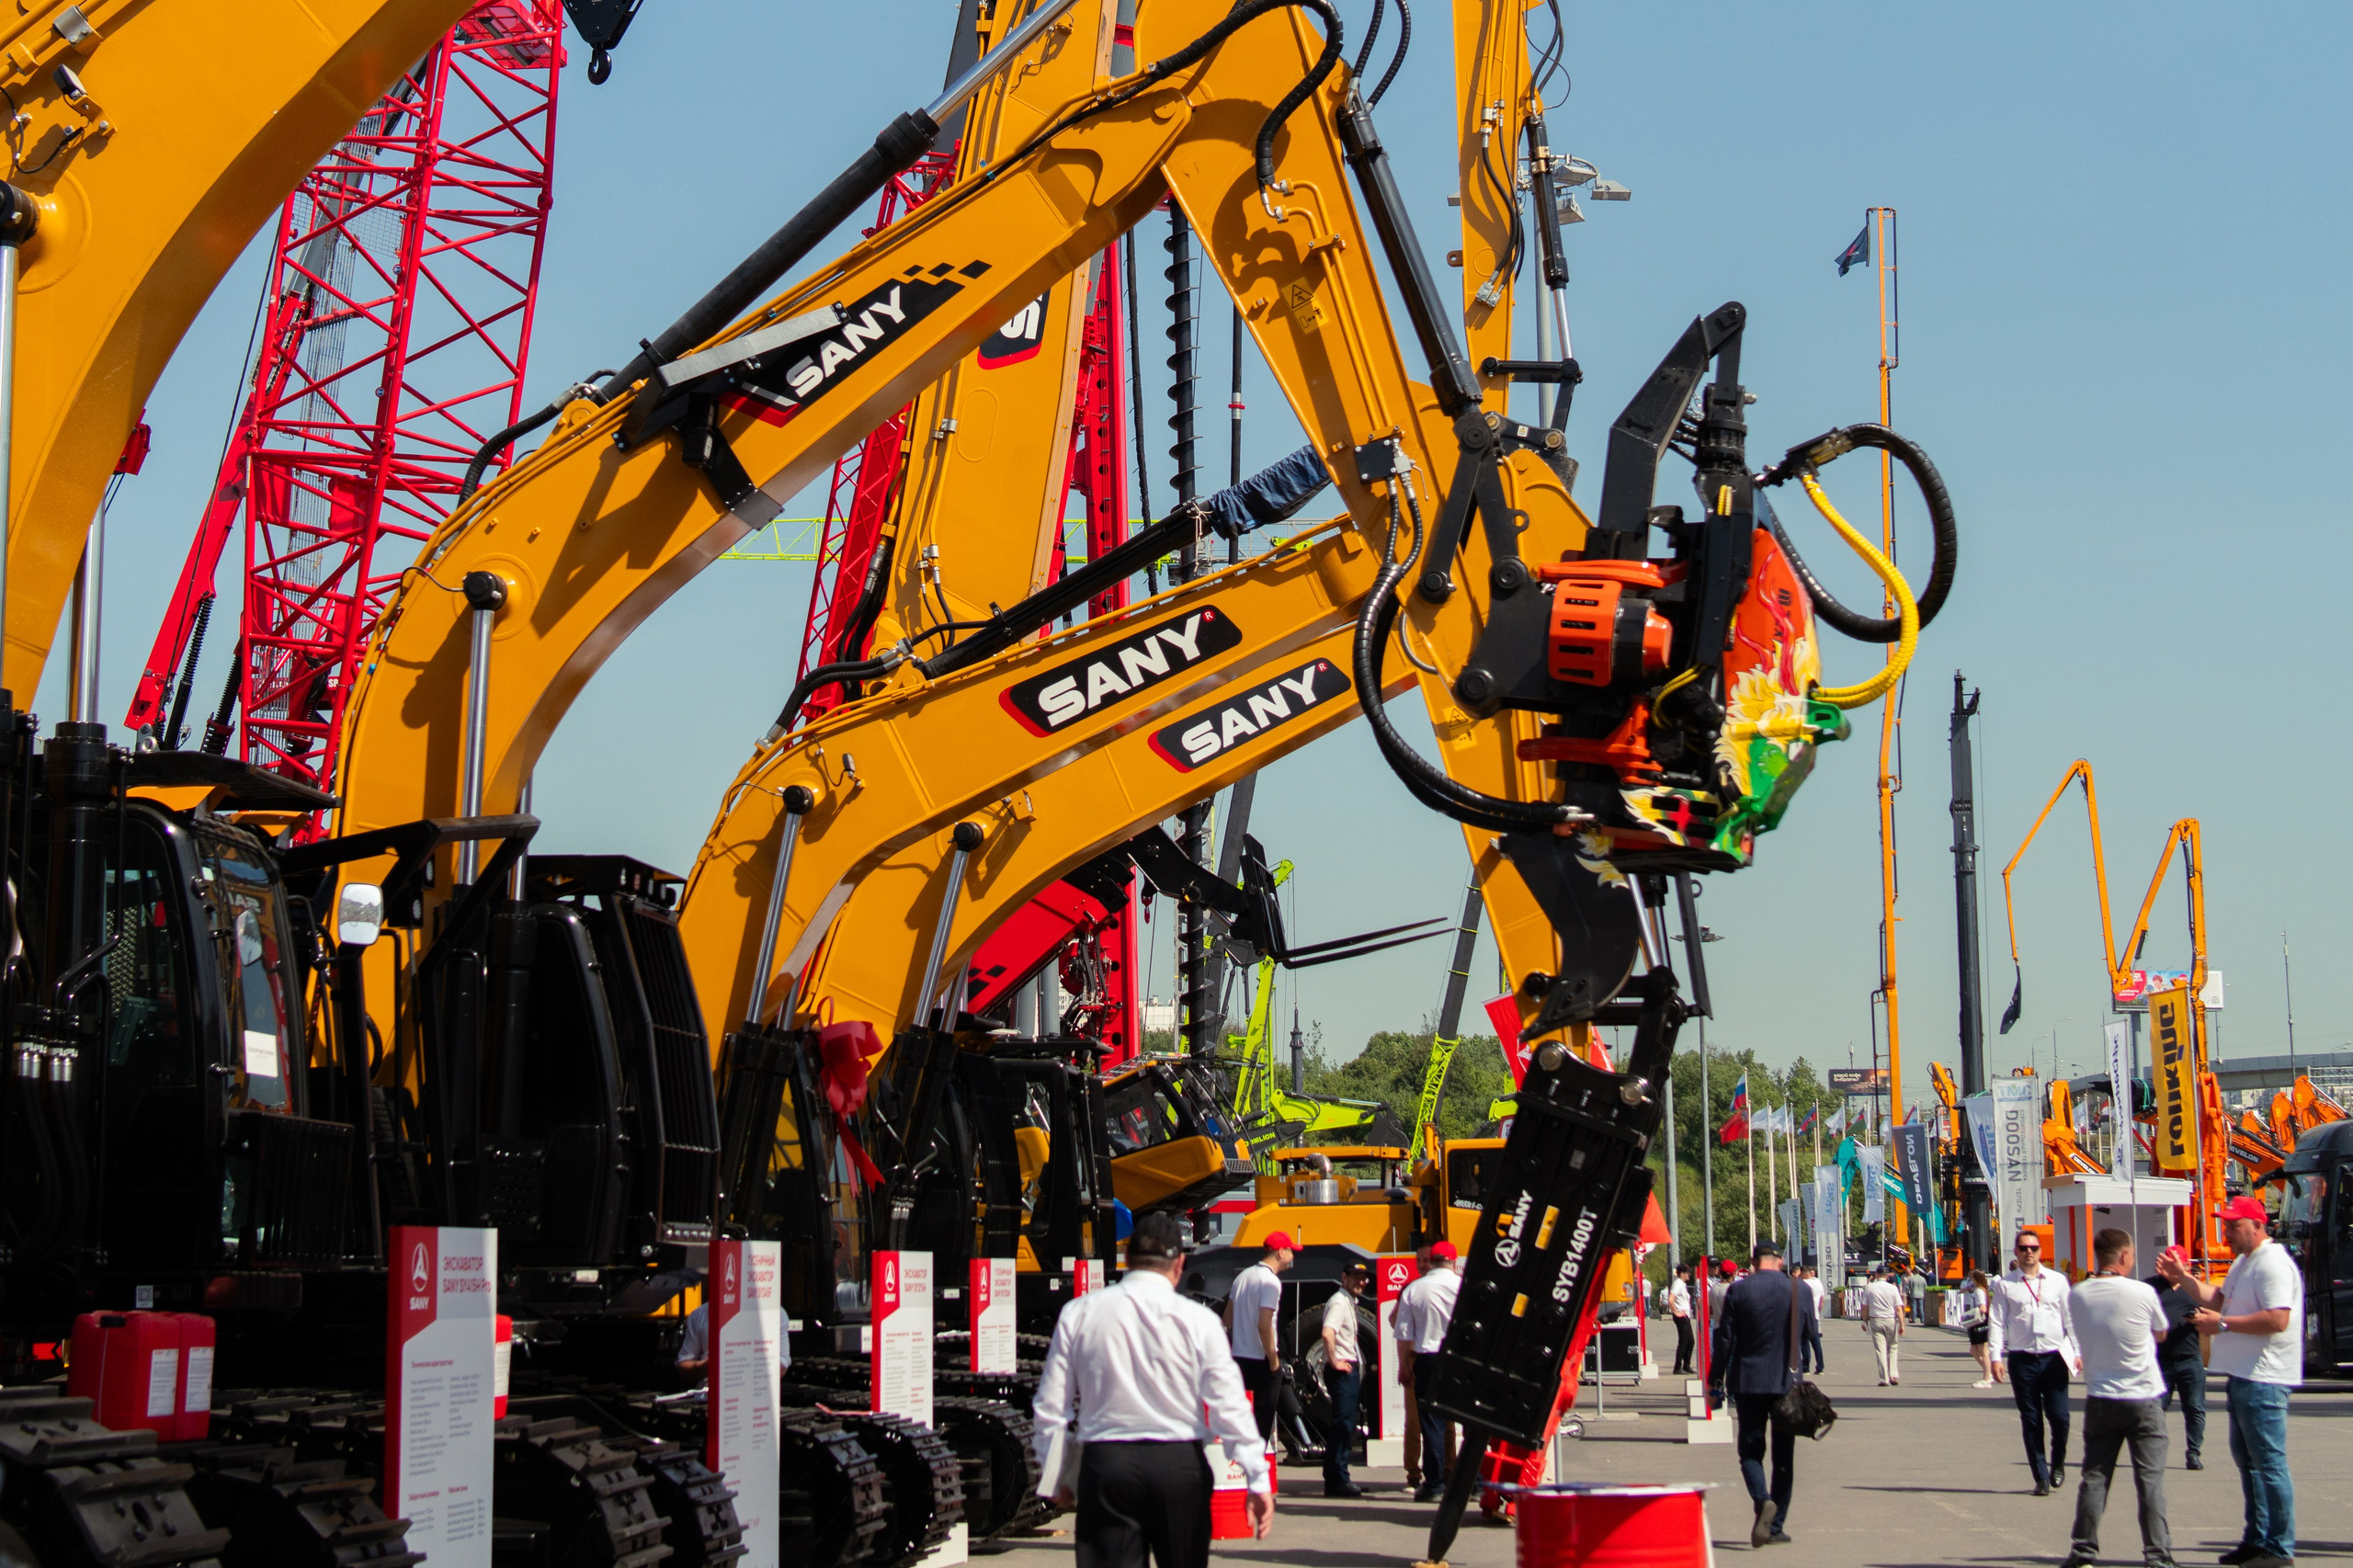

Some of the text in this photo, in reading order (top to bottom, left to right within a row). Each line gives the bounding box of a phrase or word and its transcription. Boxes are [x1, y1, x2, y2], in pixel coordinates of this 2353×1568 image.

[786, 285, 907, 398] SANY
[1038, 612, 1202, 727] SANY
[1181, 664, 1318, 764] SANY
[1245, 1131, 1276, 1147] OOMLION
[2005, 1109, 2022, 1183] DOOSAN
[2230, 1144, 2260, 1164] EVELON
[1507, 1188, 1534, 1240] SANY
[1552, 1205, 1598, 1303] SYB1400T
[1824, 1245, 1834, 1296] DEVELON
[409, 1296, 430, 1312] SANY
[883, 1292, 896, 1302] SANY
